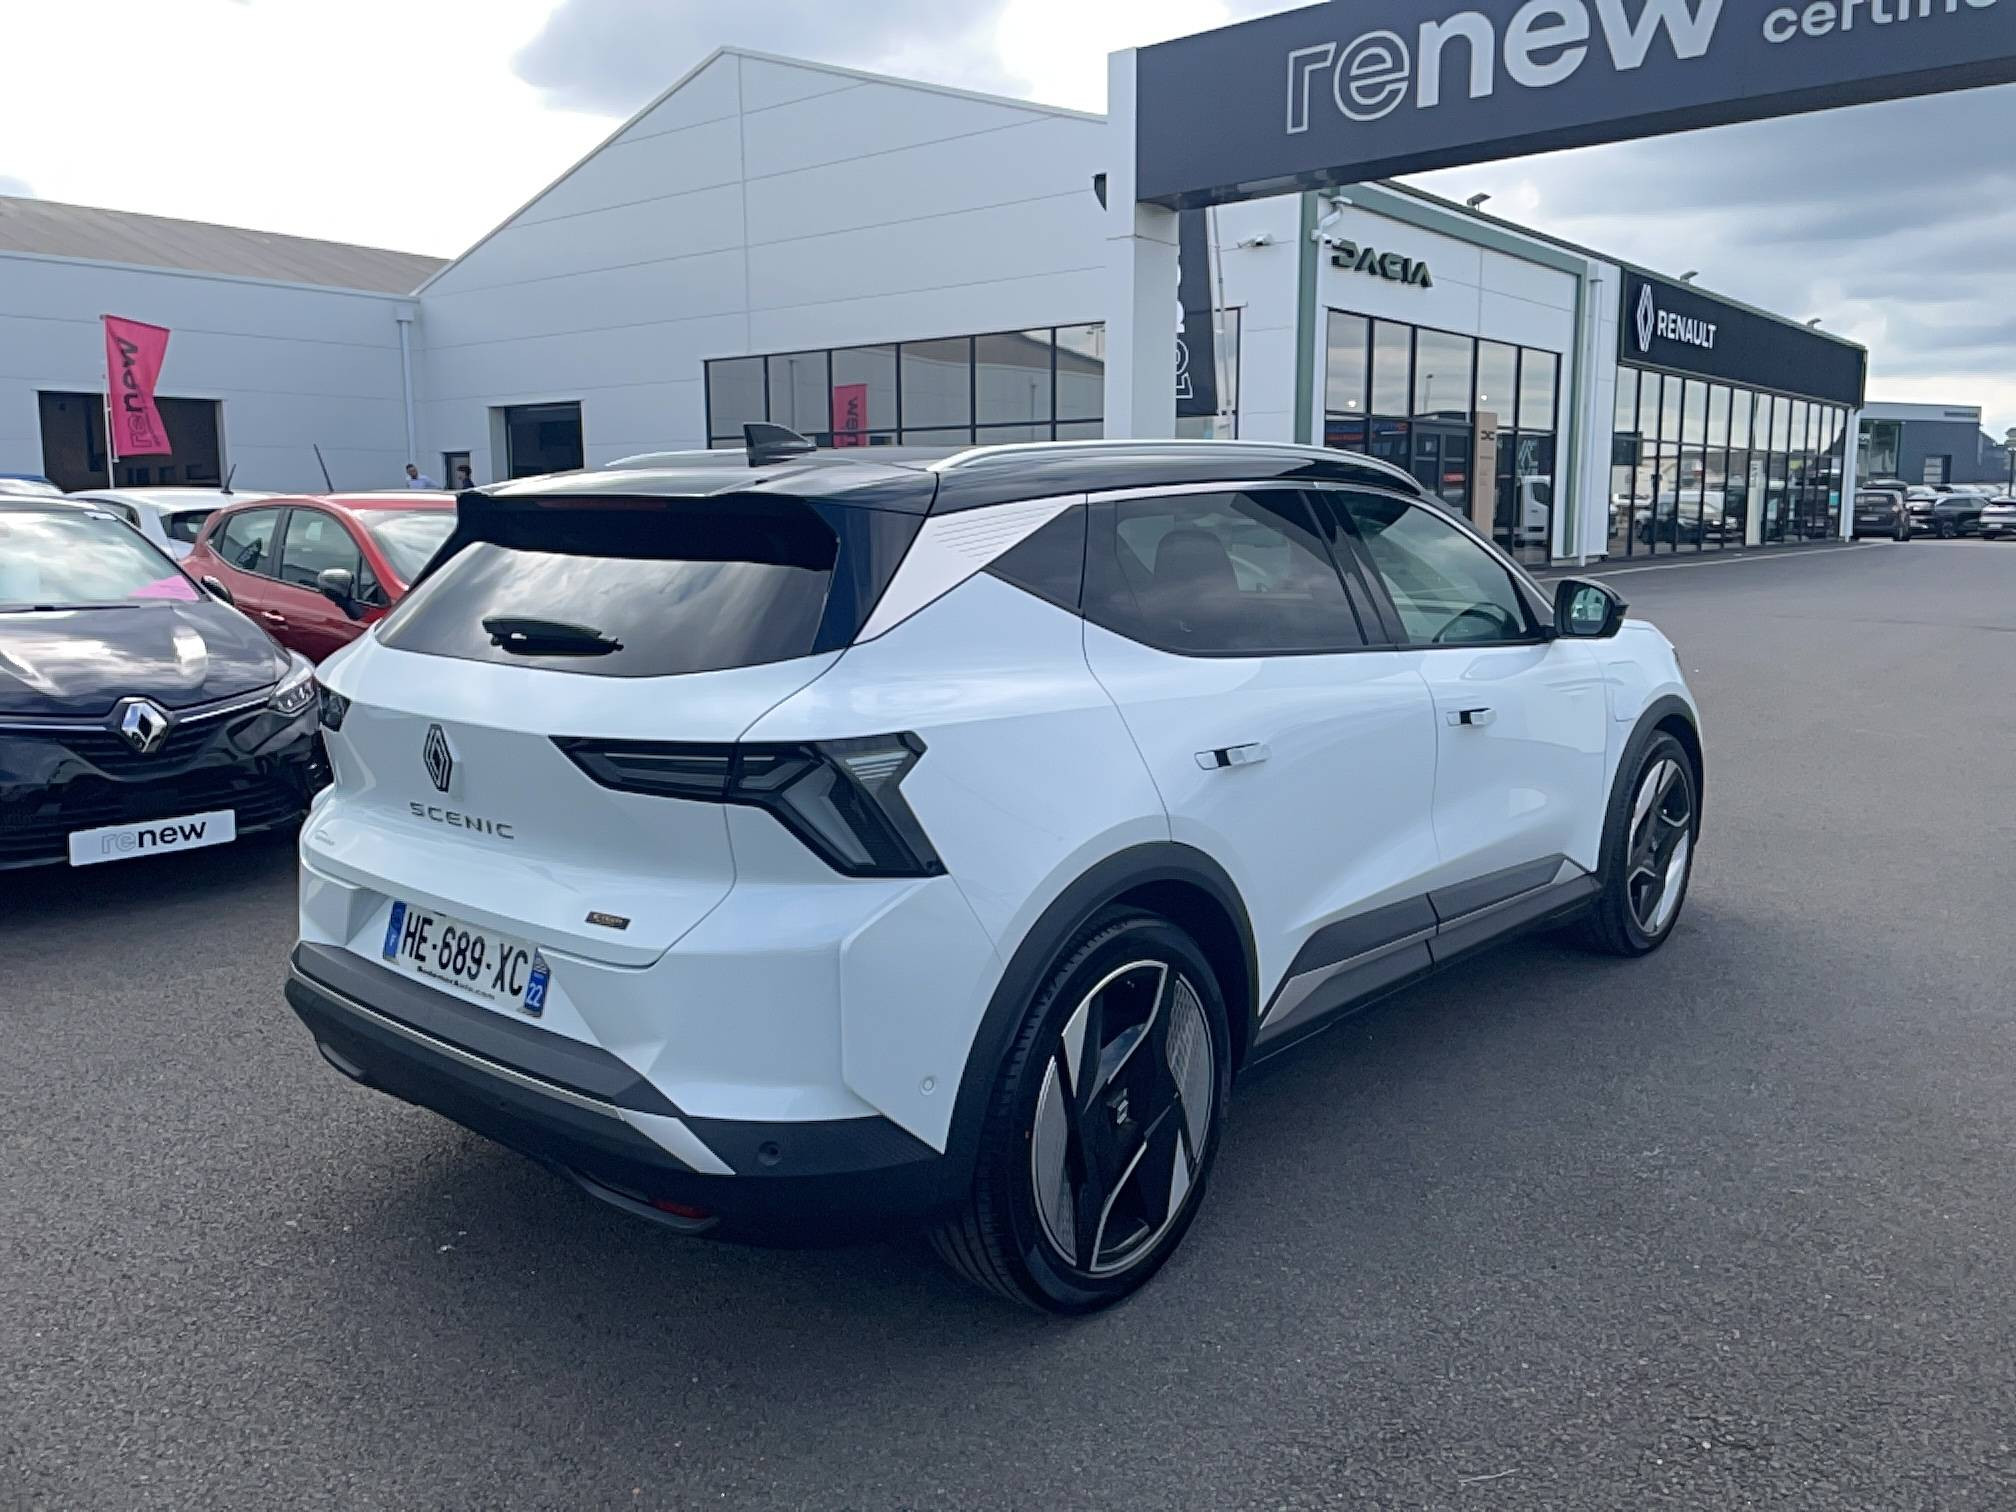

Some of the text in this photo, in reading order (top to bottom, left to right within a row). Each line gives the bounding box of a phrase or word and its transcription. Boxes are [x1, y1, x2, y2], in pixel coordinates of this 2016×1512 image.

[1286, 0, 1724, 135] renew
[1330, 238, 1433, 289] DACIA
[1656, 308, 1718, 350] RENAULT
[114, 335, 153, 449] renew
[101, 819, 208, 856] renew
[408, 801, 515, 840] SCENIC
[400, 910, 529, 997] HE-689-XC
[526, 982, 544, 1008] 22
